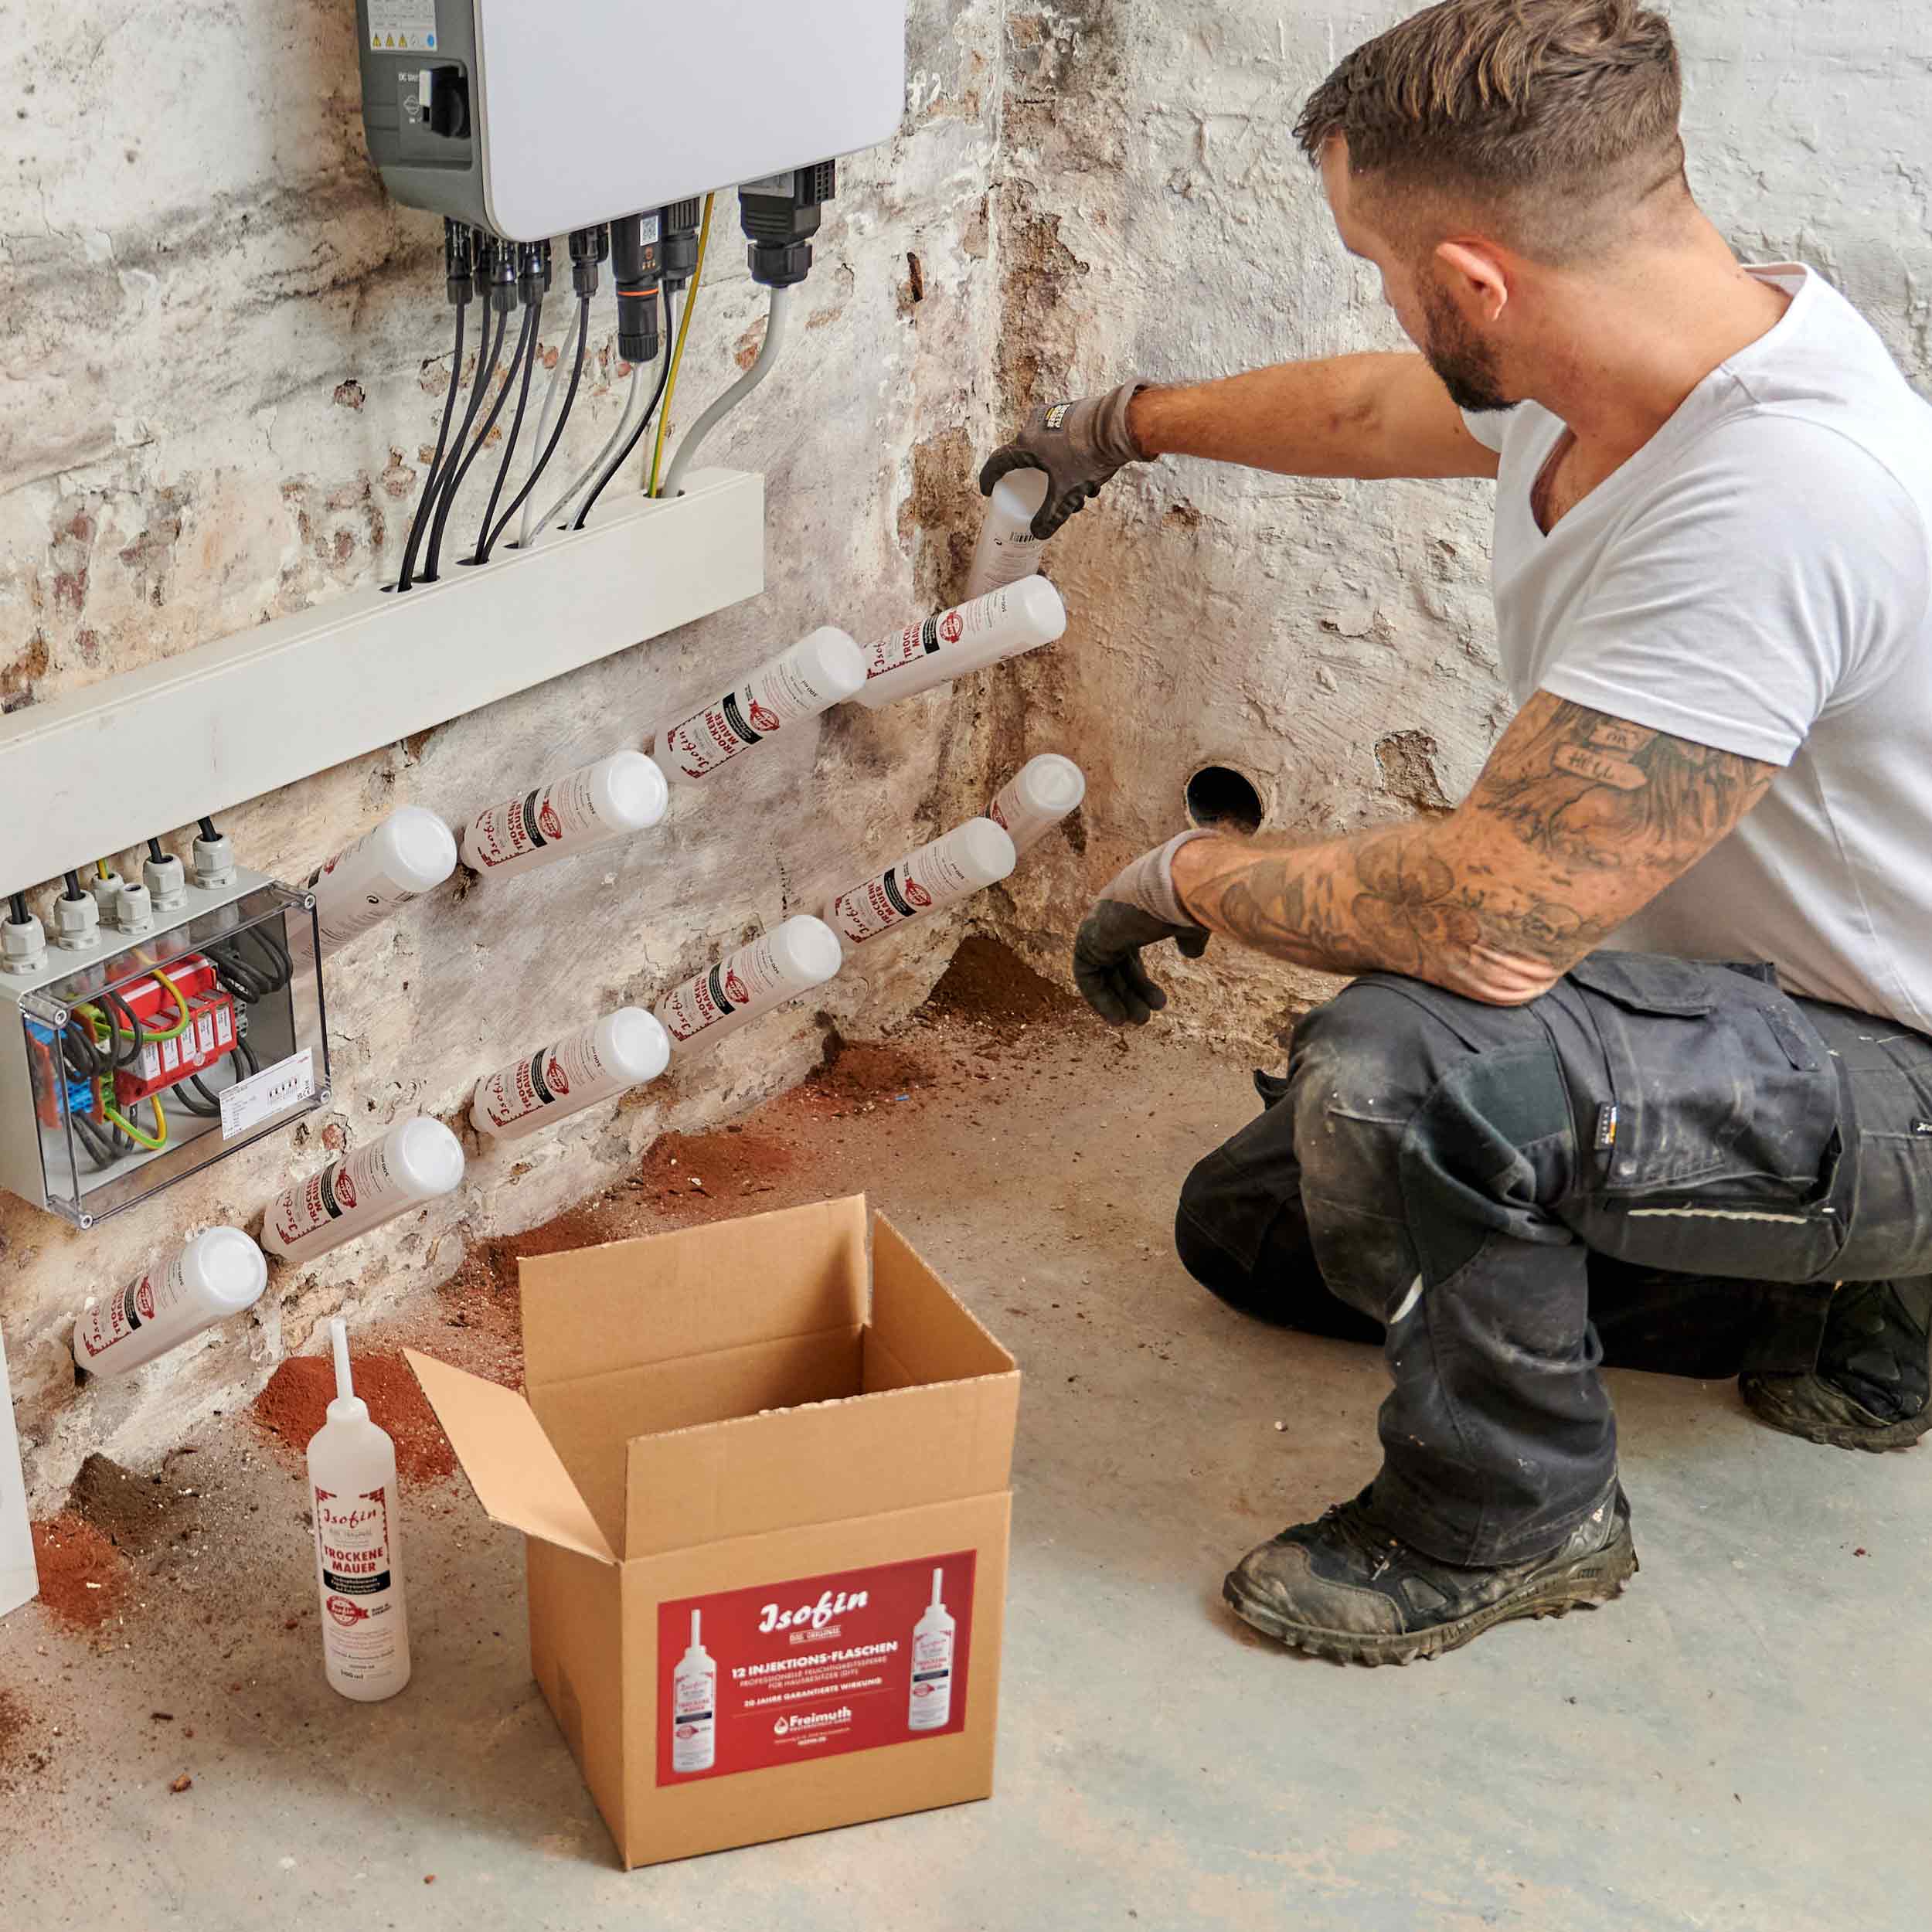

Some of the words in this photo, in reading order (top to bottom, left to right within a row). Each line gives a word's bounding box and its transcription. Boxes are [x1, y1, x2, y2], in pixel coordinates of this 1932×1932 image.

[704, 710, 735, 754] TROCKENE
[715, 712, 740, 747] MAUER
[515, 803, 527, 841] MAUER
[866, 882, 892, 927] TROCKENE
[874, 884, 896, 916] MAUER
[522, 1063, 536, 1099] MAUER
[323, 1508, 376, 1529] Isofin
[324, 1545, 384, 1562] TROCKENE
[332, 1560, 376, 1573] MAUER
[758, 1590, 869, 1633] Isofin
[731, 1667, 747, 1679] 12
[748, 1640, 899, 1676] INJEKTIONS-FLASCHEN
[740, 1671, 803, 1688] PROFESSIONELLE
[757, 1694, 783, 1706] JAHRE
[784, 1684, 838, 1700] GARANTIERTE
[840, 1676, 883, 1690] WIRKUNG
[784, 1671, 838, 1687] HAUSBESITZER
[789, 1706, 852, 1726] Freimuth
